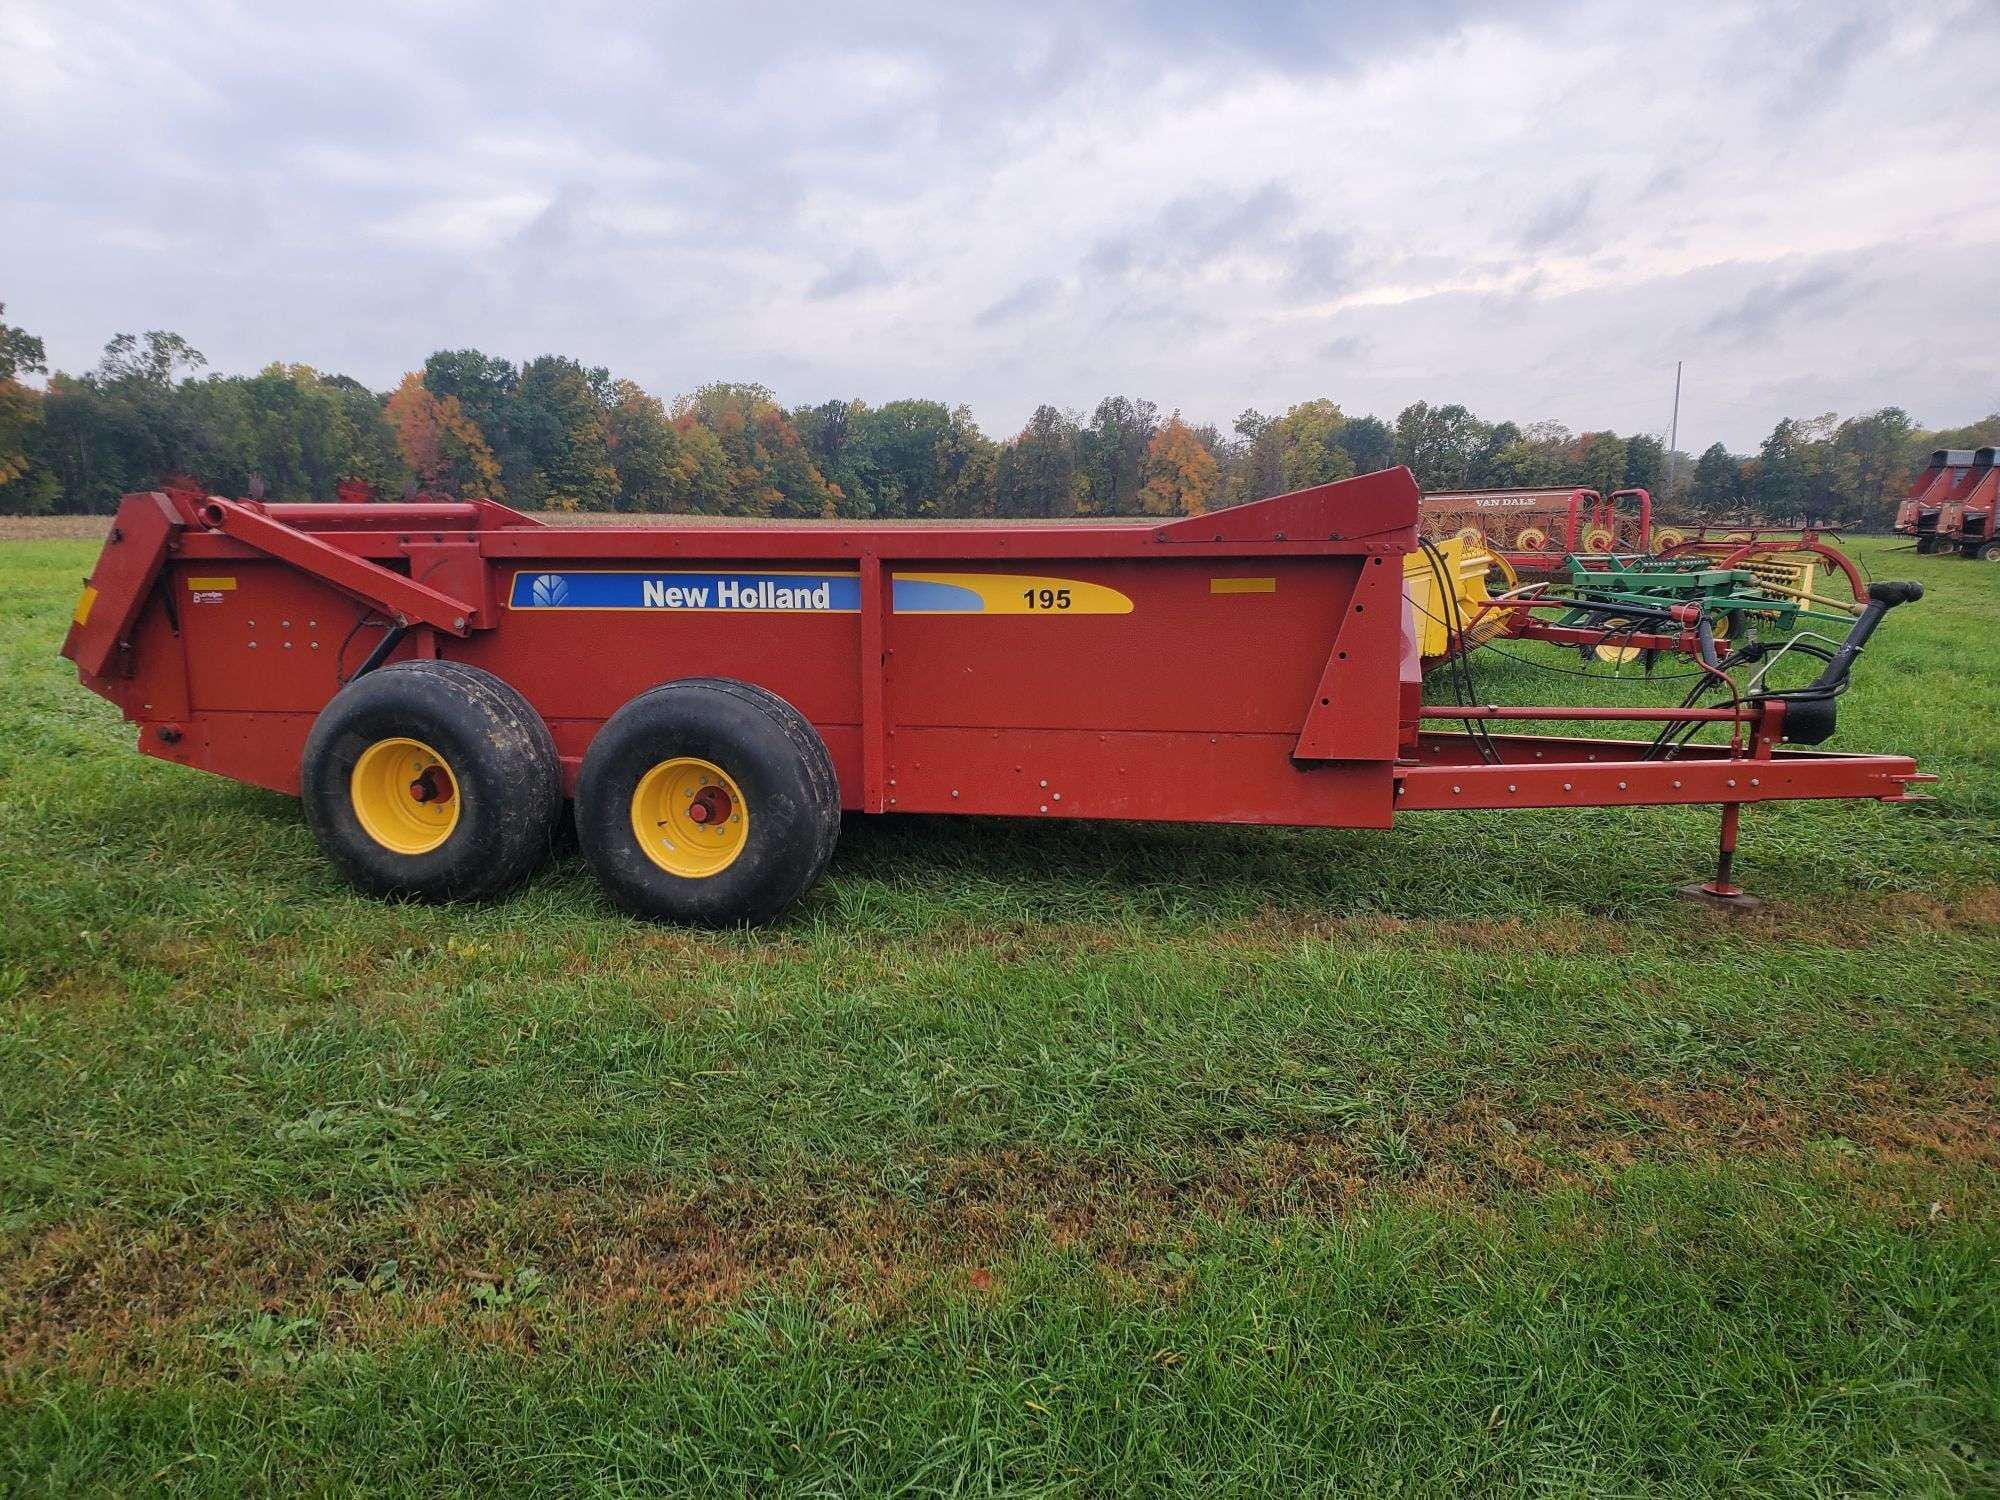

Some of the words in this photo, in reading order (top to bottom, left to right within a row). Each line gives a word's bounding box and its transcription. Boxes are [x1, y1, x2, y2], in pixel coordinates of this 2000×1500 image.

[1476, 499, 1499, 507] VAN
[1503, 498, 1536, 506] DALE
[643, 580, 709, 608] New
[717, 581, 830, 609] Holland
[1023, 588, 1071, 610] 195
